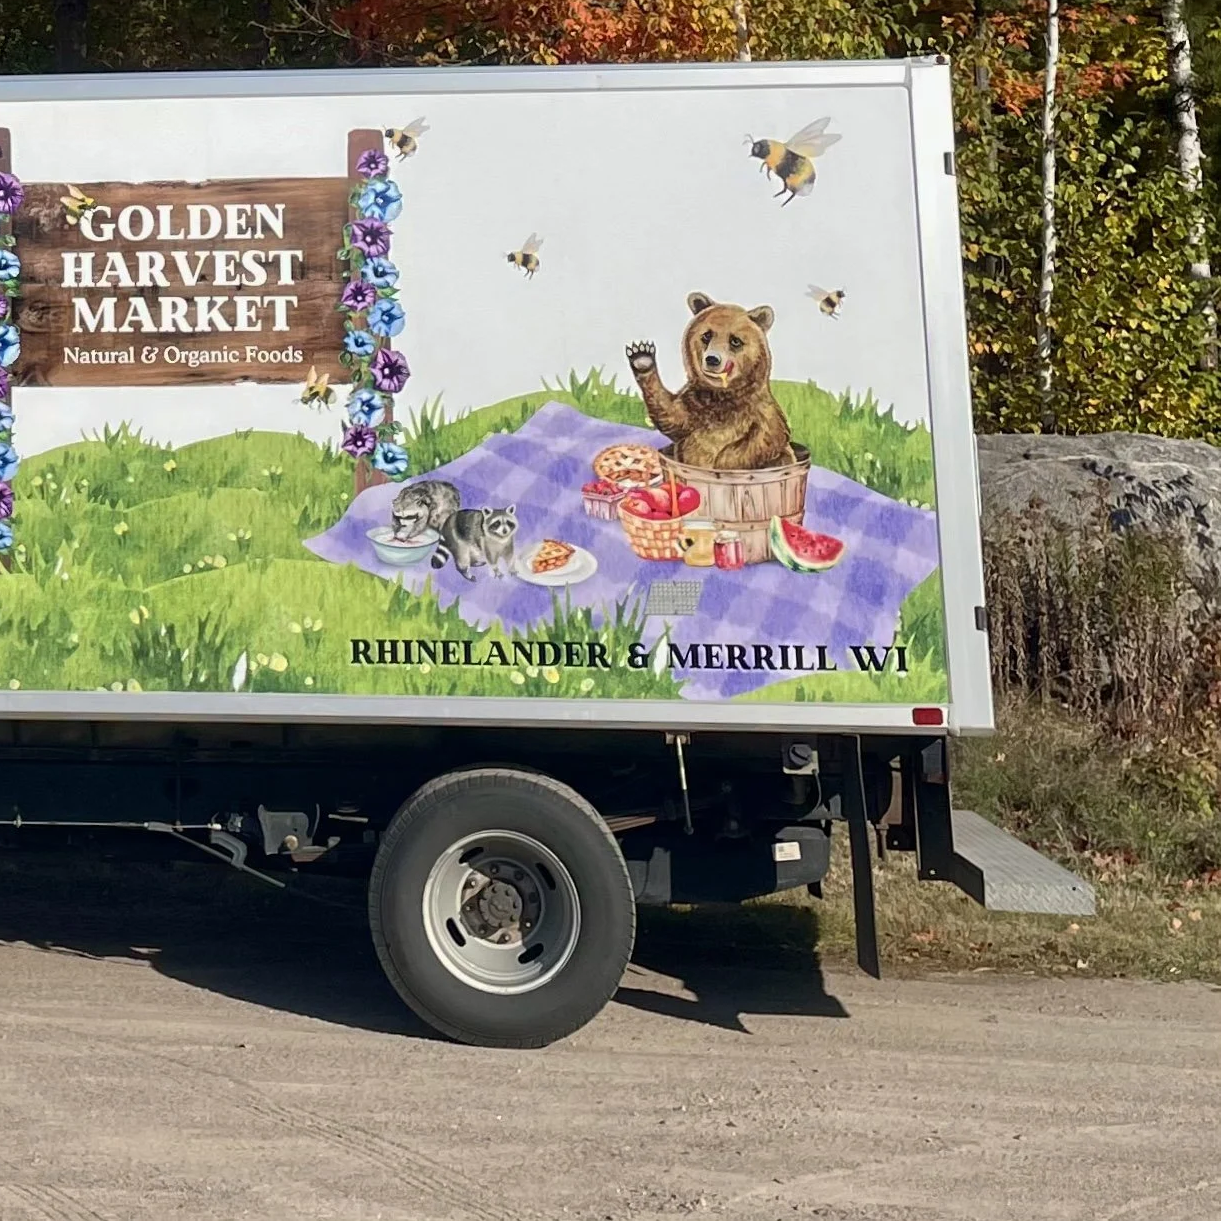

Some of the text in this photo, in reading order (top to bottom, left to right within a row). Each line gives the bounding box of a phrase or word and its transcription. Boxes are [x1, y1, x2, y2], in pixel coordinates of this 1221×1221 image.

[80, 204, 286, 241] GOLDEN
[61, 250, 303, 287] HARVEST
[72, 296, 298, 333] MARKET
[63, 345, 304, 368] Natural & Organic Foods
[350, 639, 909, 672] RHINELANDER & MERRILL WI
